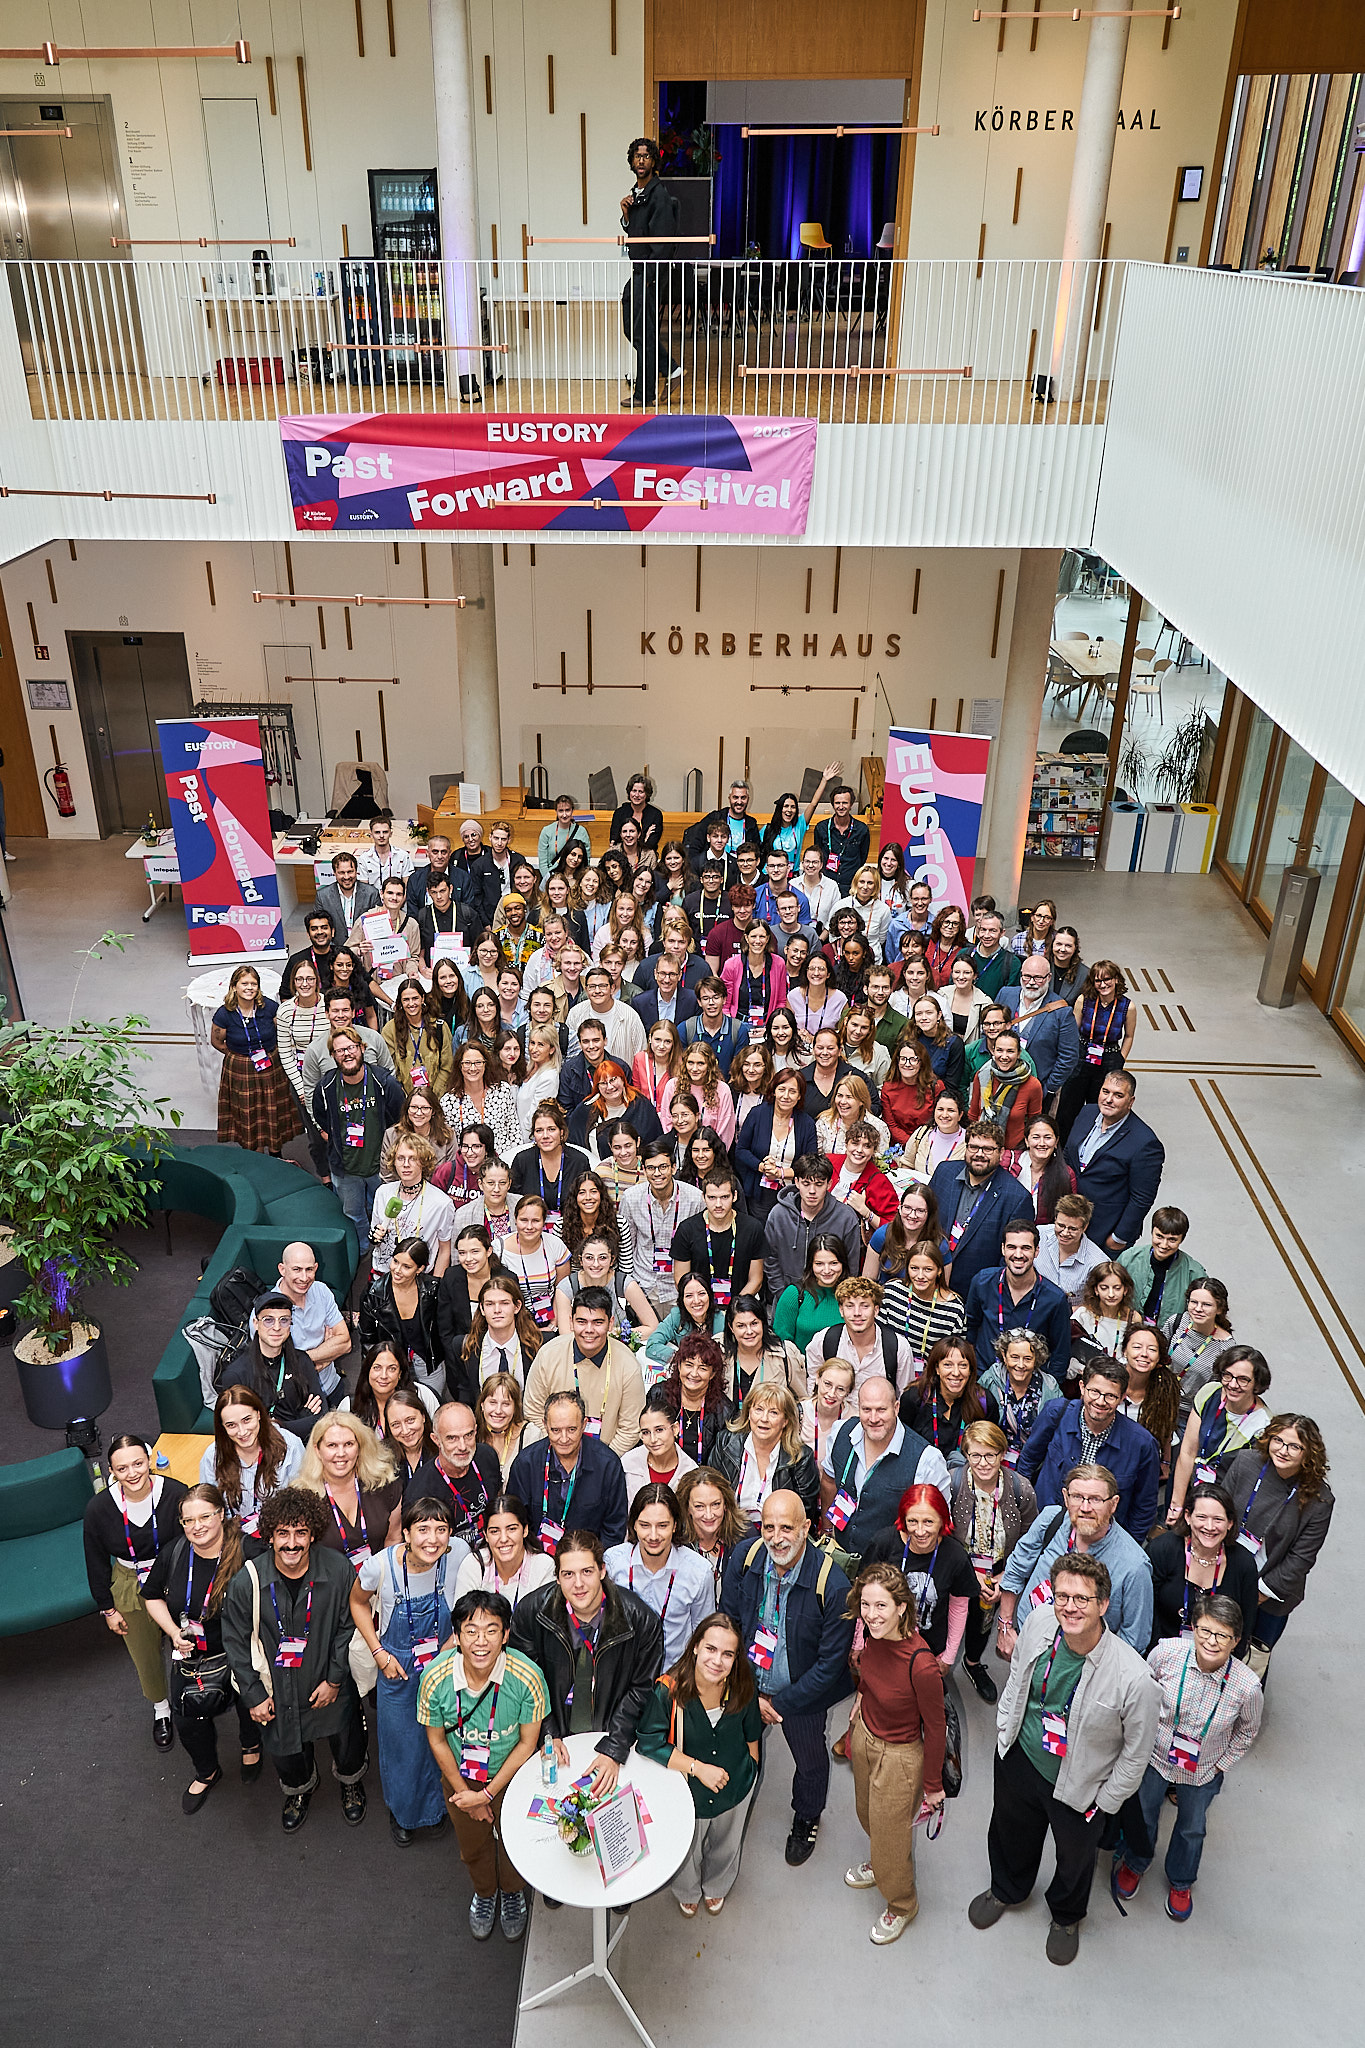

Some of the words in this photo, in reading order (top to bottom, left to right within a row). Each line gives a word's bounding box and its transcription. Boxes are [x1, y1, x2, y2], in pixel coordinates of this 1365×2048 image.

[974, 105, 1074, 131] KÖRBER
[1117, 109, 1161, 130] AAL
[487, 422, 609, 444] EUSTORY
[752, 425, 792, 439] 2026
[304, 445, 394, 480] Past
[406, 462, 574, 522] Forward
[633, 468, 792, 510] Festival
[640, 625, 902, 658] KÖRBERHAUS
[184, 739, 238, 752] EUSTORY
[178, 773, 210, 824] Past
[220, 817, 265, 904] Forward
[191, 906, 277, 928] Festival
[249, 936, 277, 948] 2026
